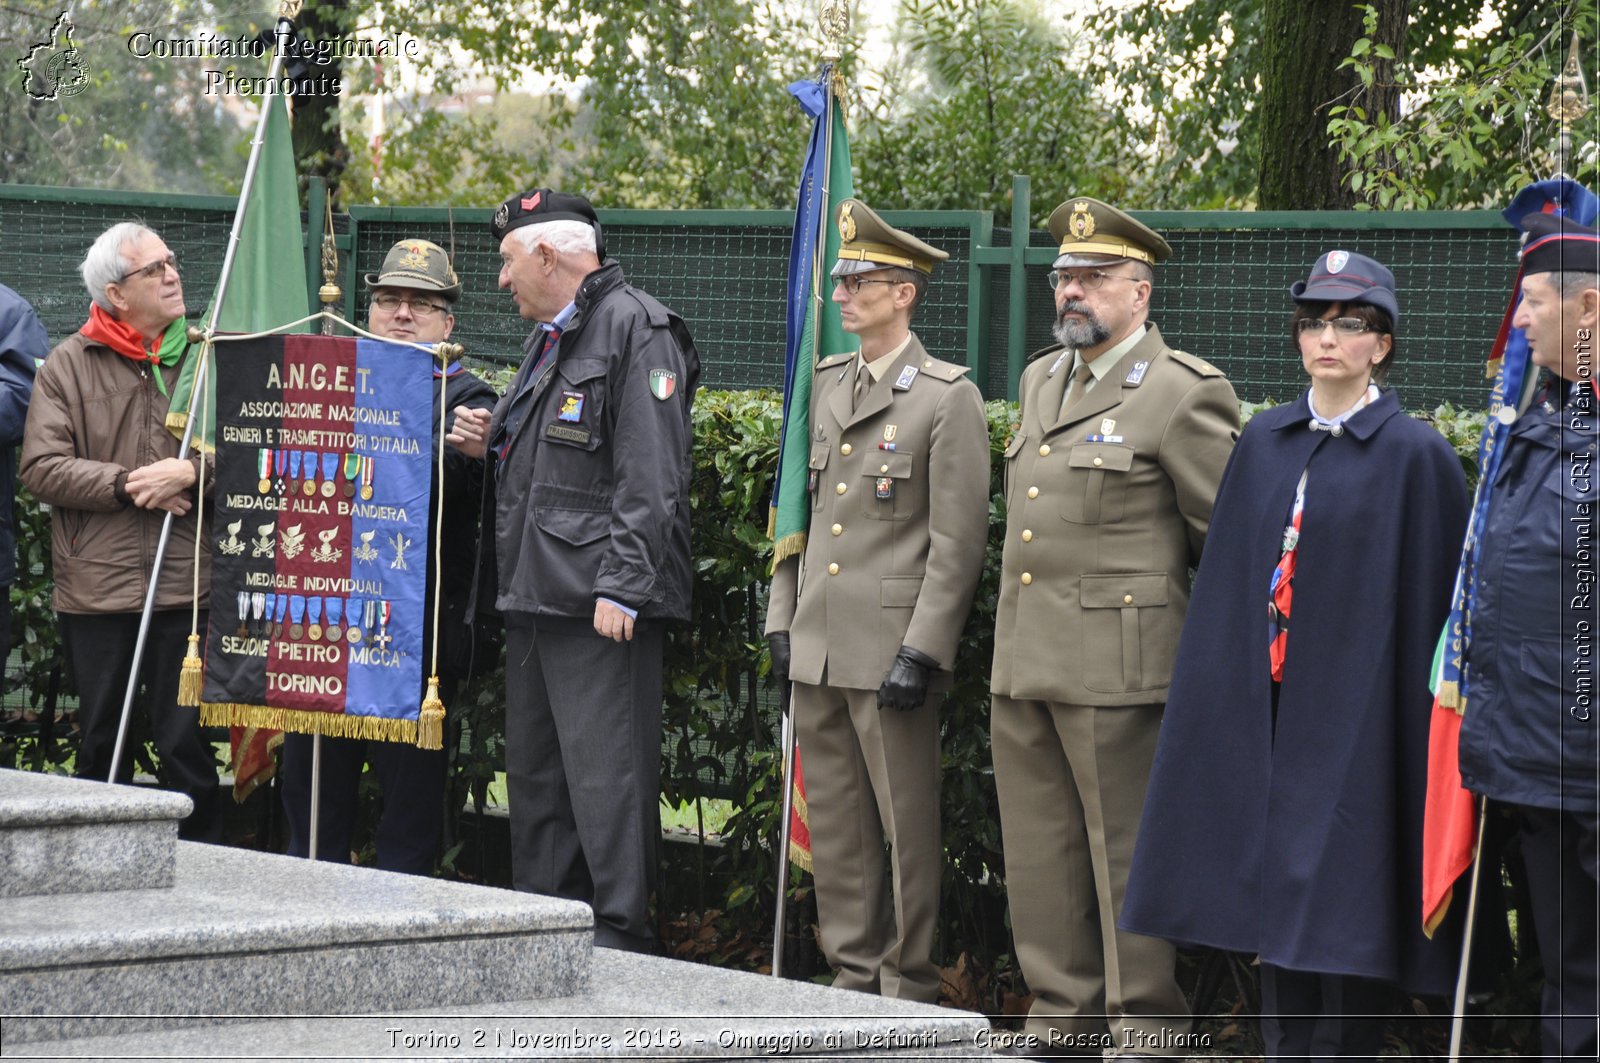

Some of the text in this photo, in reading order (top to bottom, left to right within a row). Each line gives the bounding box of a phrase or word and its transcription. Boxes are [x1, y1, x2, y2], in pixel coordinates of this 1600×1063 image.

[266, 363, 375, 395] A.N.G.E.T.
[239, 401, 400, 426] ASSOCIAZIONE NAZIONALE
[223, 425, 420, 455] GENIERI E TRASMETTITORI D'ITALIA
[226, 494, 408, 523] MEDAGLIE ALLA BANDIERA
[245, 572, 383, 596] MEDAGLIE INDIVIDUALI
[221, 635, 407, 669] SEZIONE "PIETRO MICCA"
[265, 672, 342, 696] TORINO
